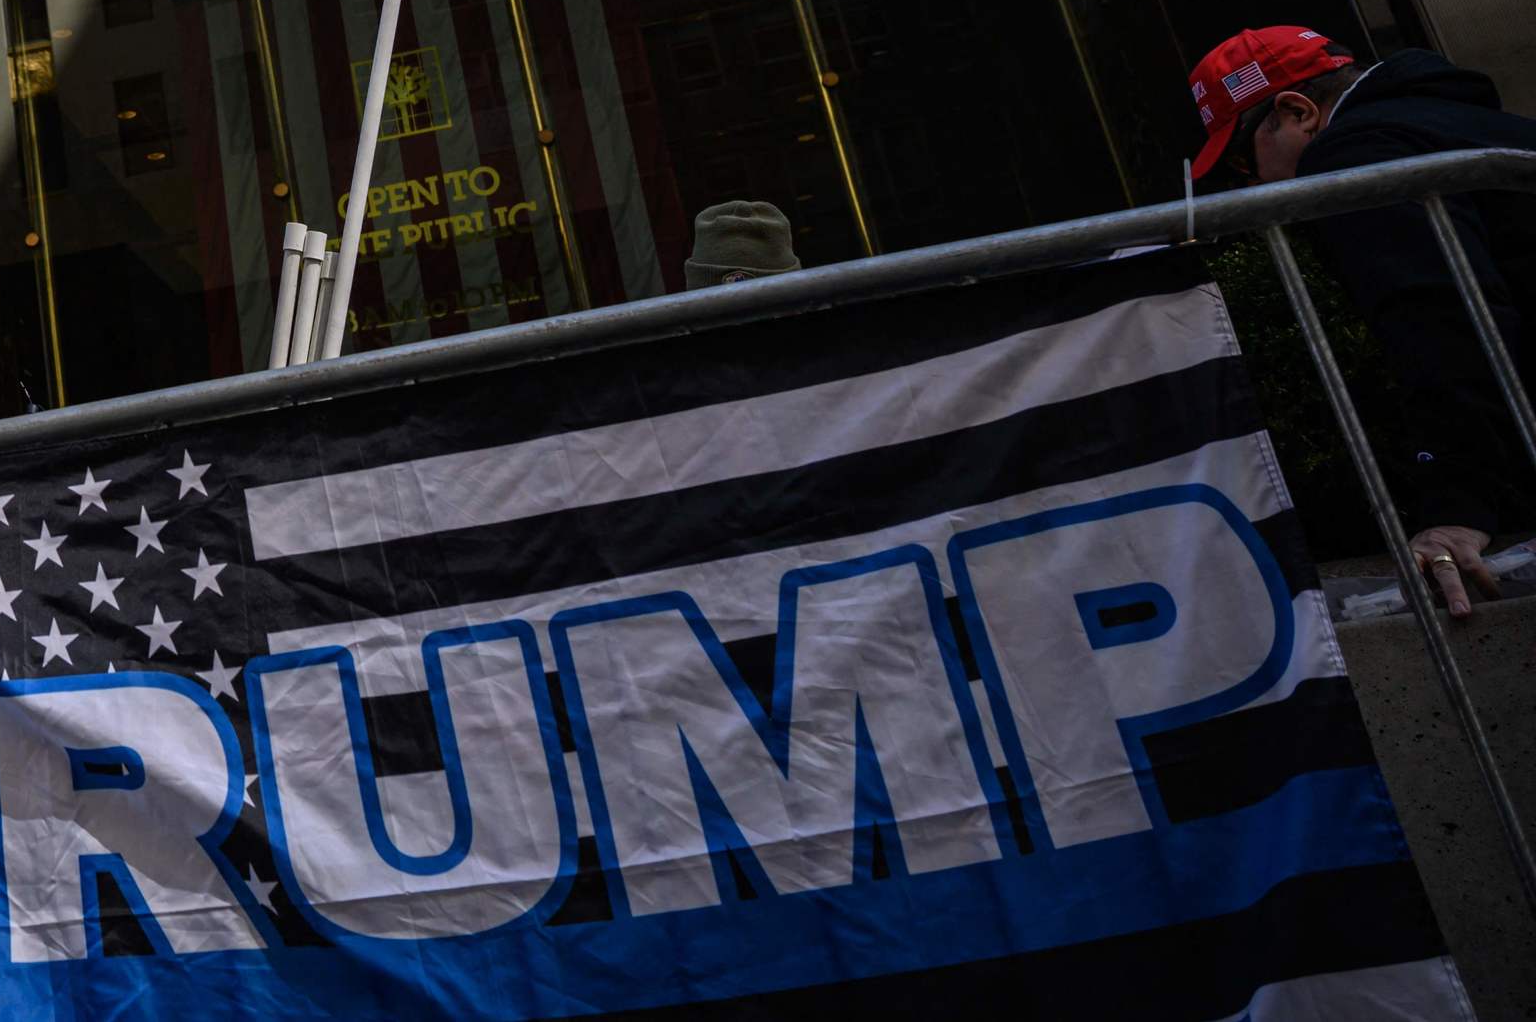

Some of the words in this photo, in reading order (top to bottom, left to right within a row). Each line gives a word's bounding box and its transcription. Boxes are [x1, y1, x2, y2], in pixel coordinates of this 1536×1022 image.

[337, 174, 441, 221] OPEN
[443, 165, 501, 202] TO
[398, 200, 538, 255] PUBLIC
